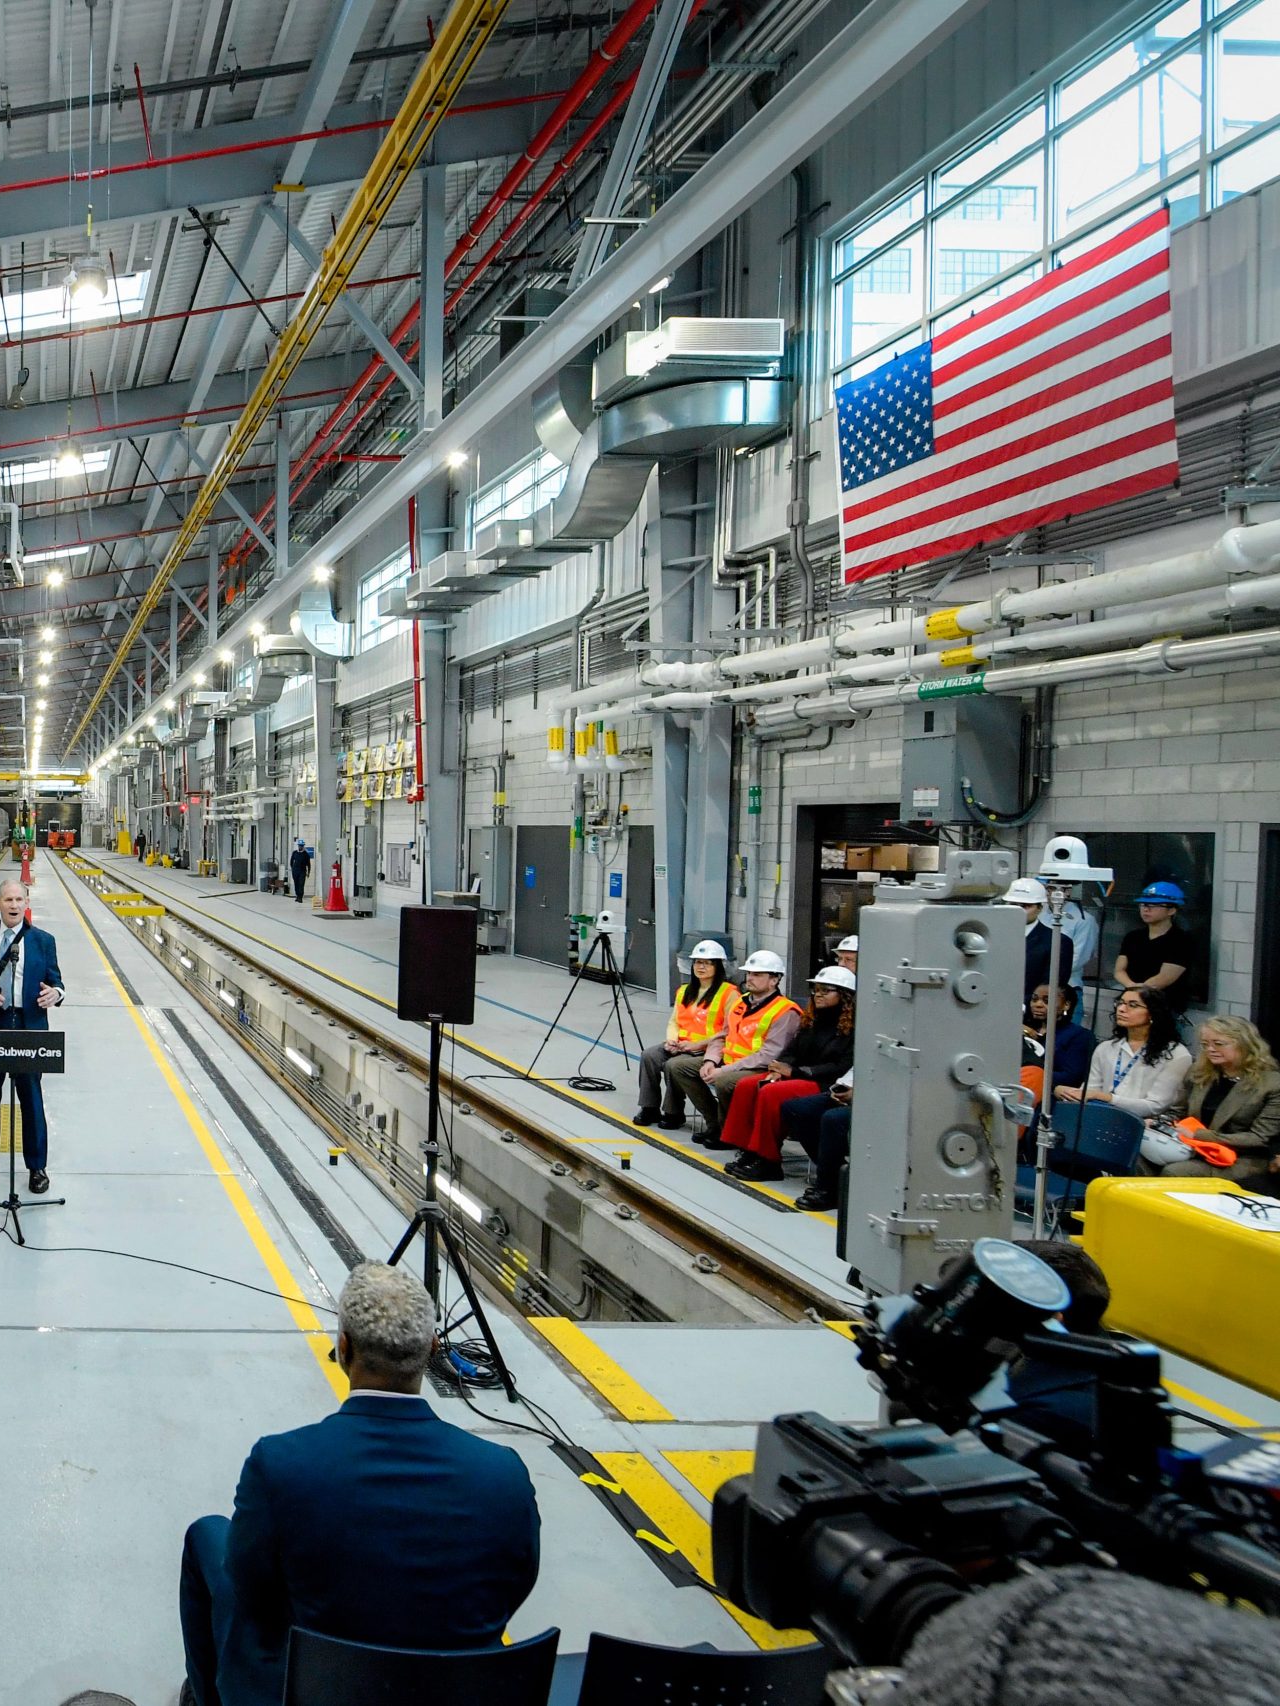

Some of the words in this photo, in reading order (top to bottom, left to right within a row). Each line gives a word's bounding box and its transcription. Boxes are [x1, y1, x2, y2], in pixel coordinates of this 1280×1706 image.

[920, 680, 945, 691] STORM
[946, 676, 973, 687] WATER
[38, 1047, 62, 1057] Cars
[917, 1193, 1006, 1212] ALSTOM
